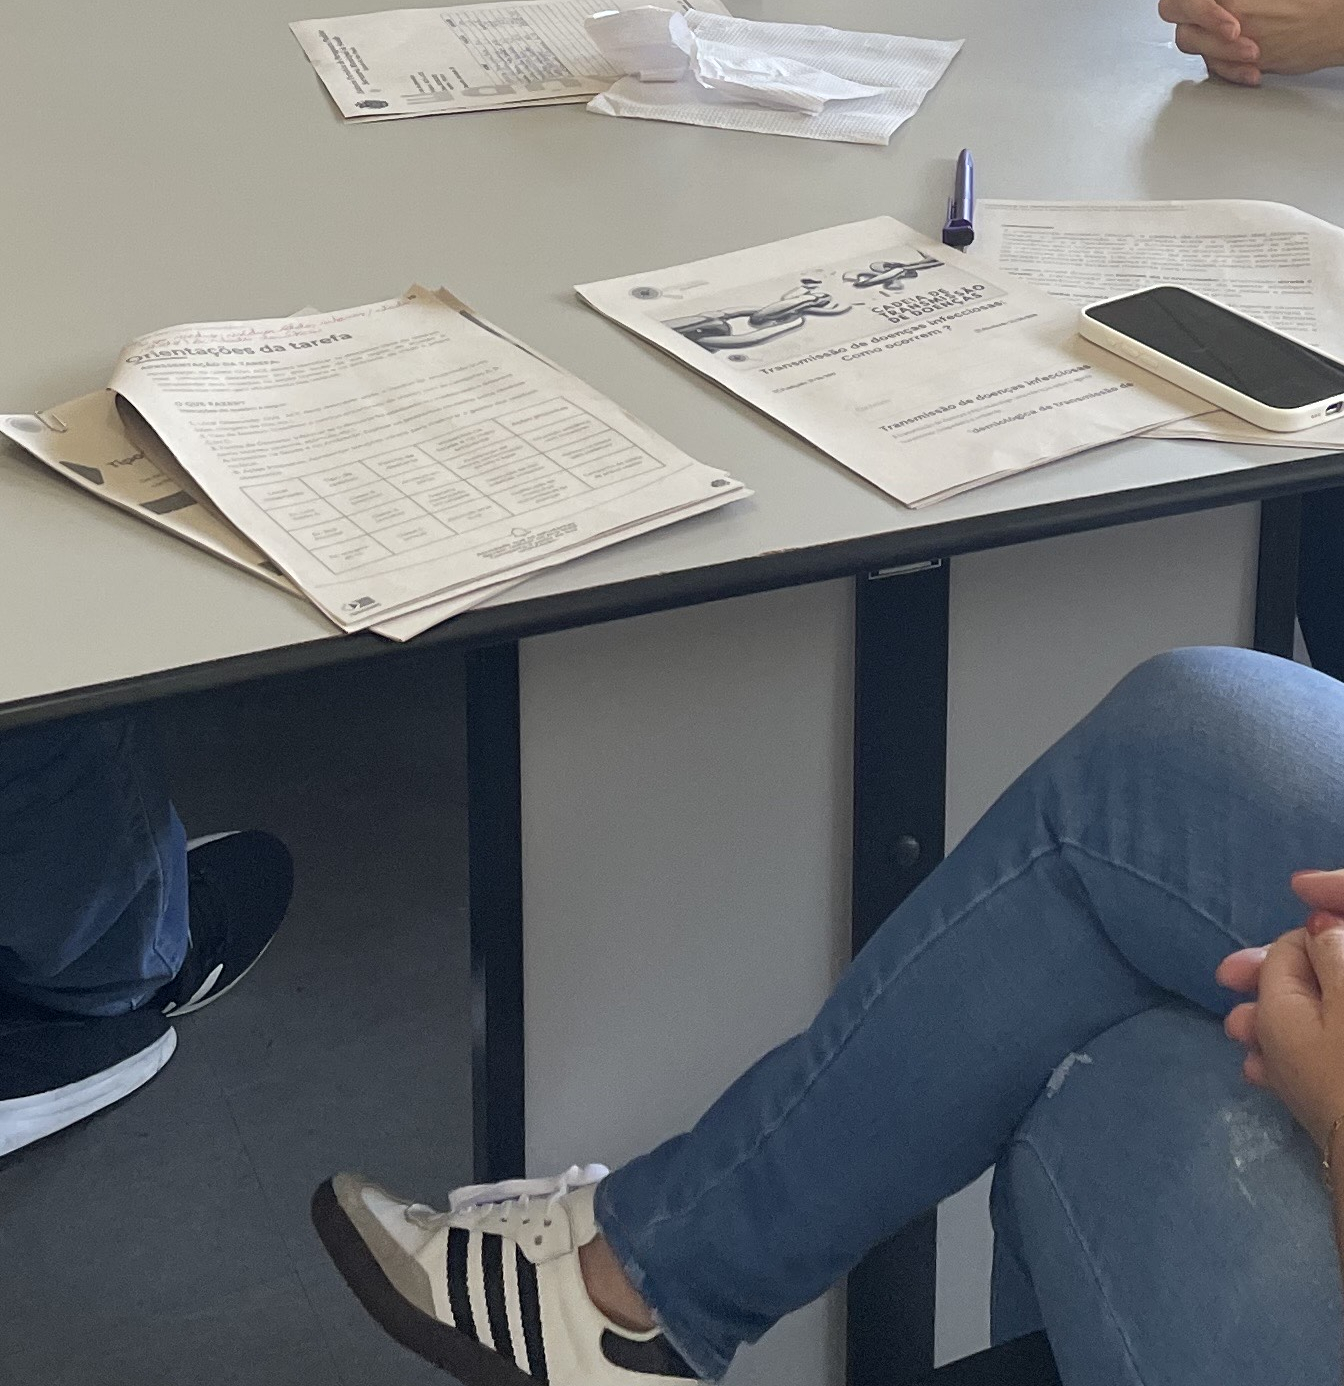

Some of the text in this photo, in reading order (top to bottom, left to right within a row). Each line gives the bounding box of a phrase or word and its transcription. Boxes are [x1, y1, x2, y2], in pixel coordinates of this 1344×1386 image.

[872, 295, 927, 314] CADEIA
[878, 284, 985, 319] TRANSMISSÃO
[911, 292, 982, 316] DOENÇAS
[125, 344, 255, 365] Orientações
[259, 343, 287, 354] da
[289, 331, 354, 350] tarefa
[760, 347, 847, 375] Transmissão
[850, 339, 869, 351] de
[871, 322, 927, 345] doenças
[841, 344, 883, 363] Como
[886, 327, 943, 353] ocorrem
[878, 404, 957, 433] Transmissão
[958, 398, 974, 409] de
[976, 383, 1025, 404] doenças
[1025, 364, 1092, 386] infecciosas
